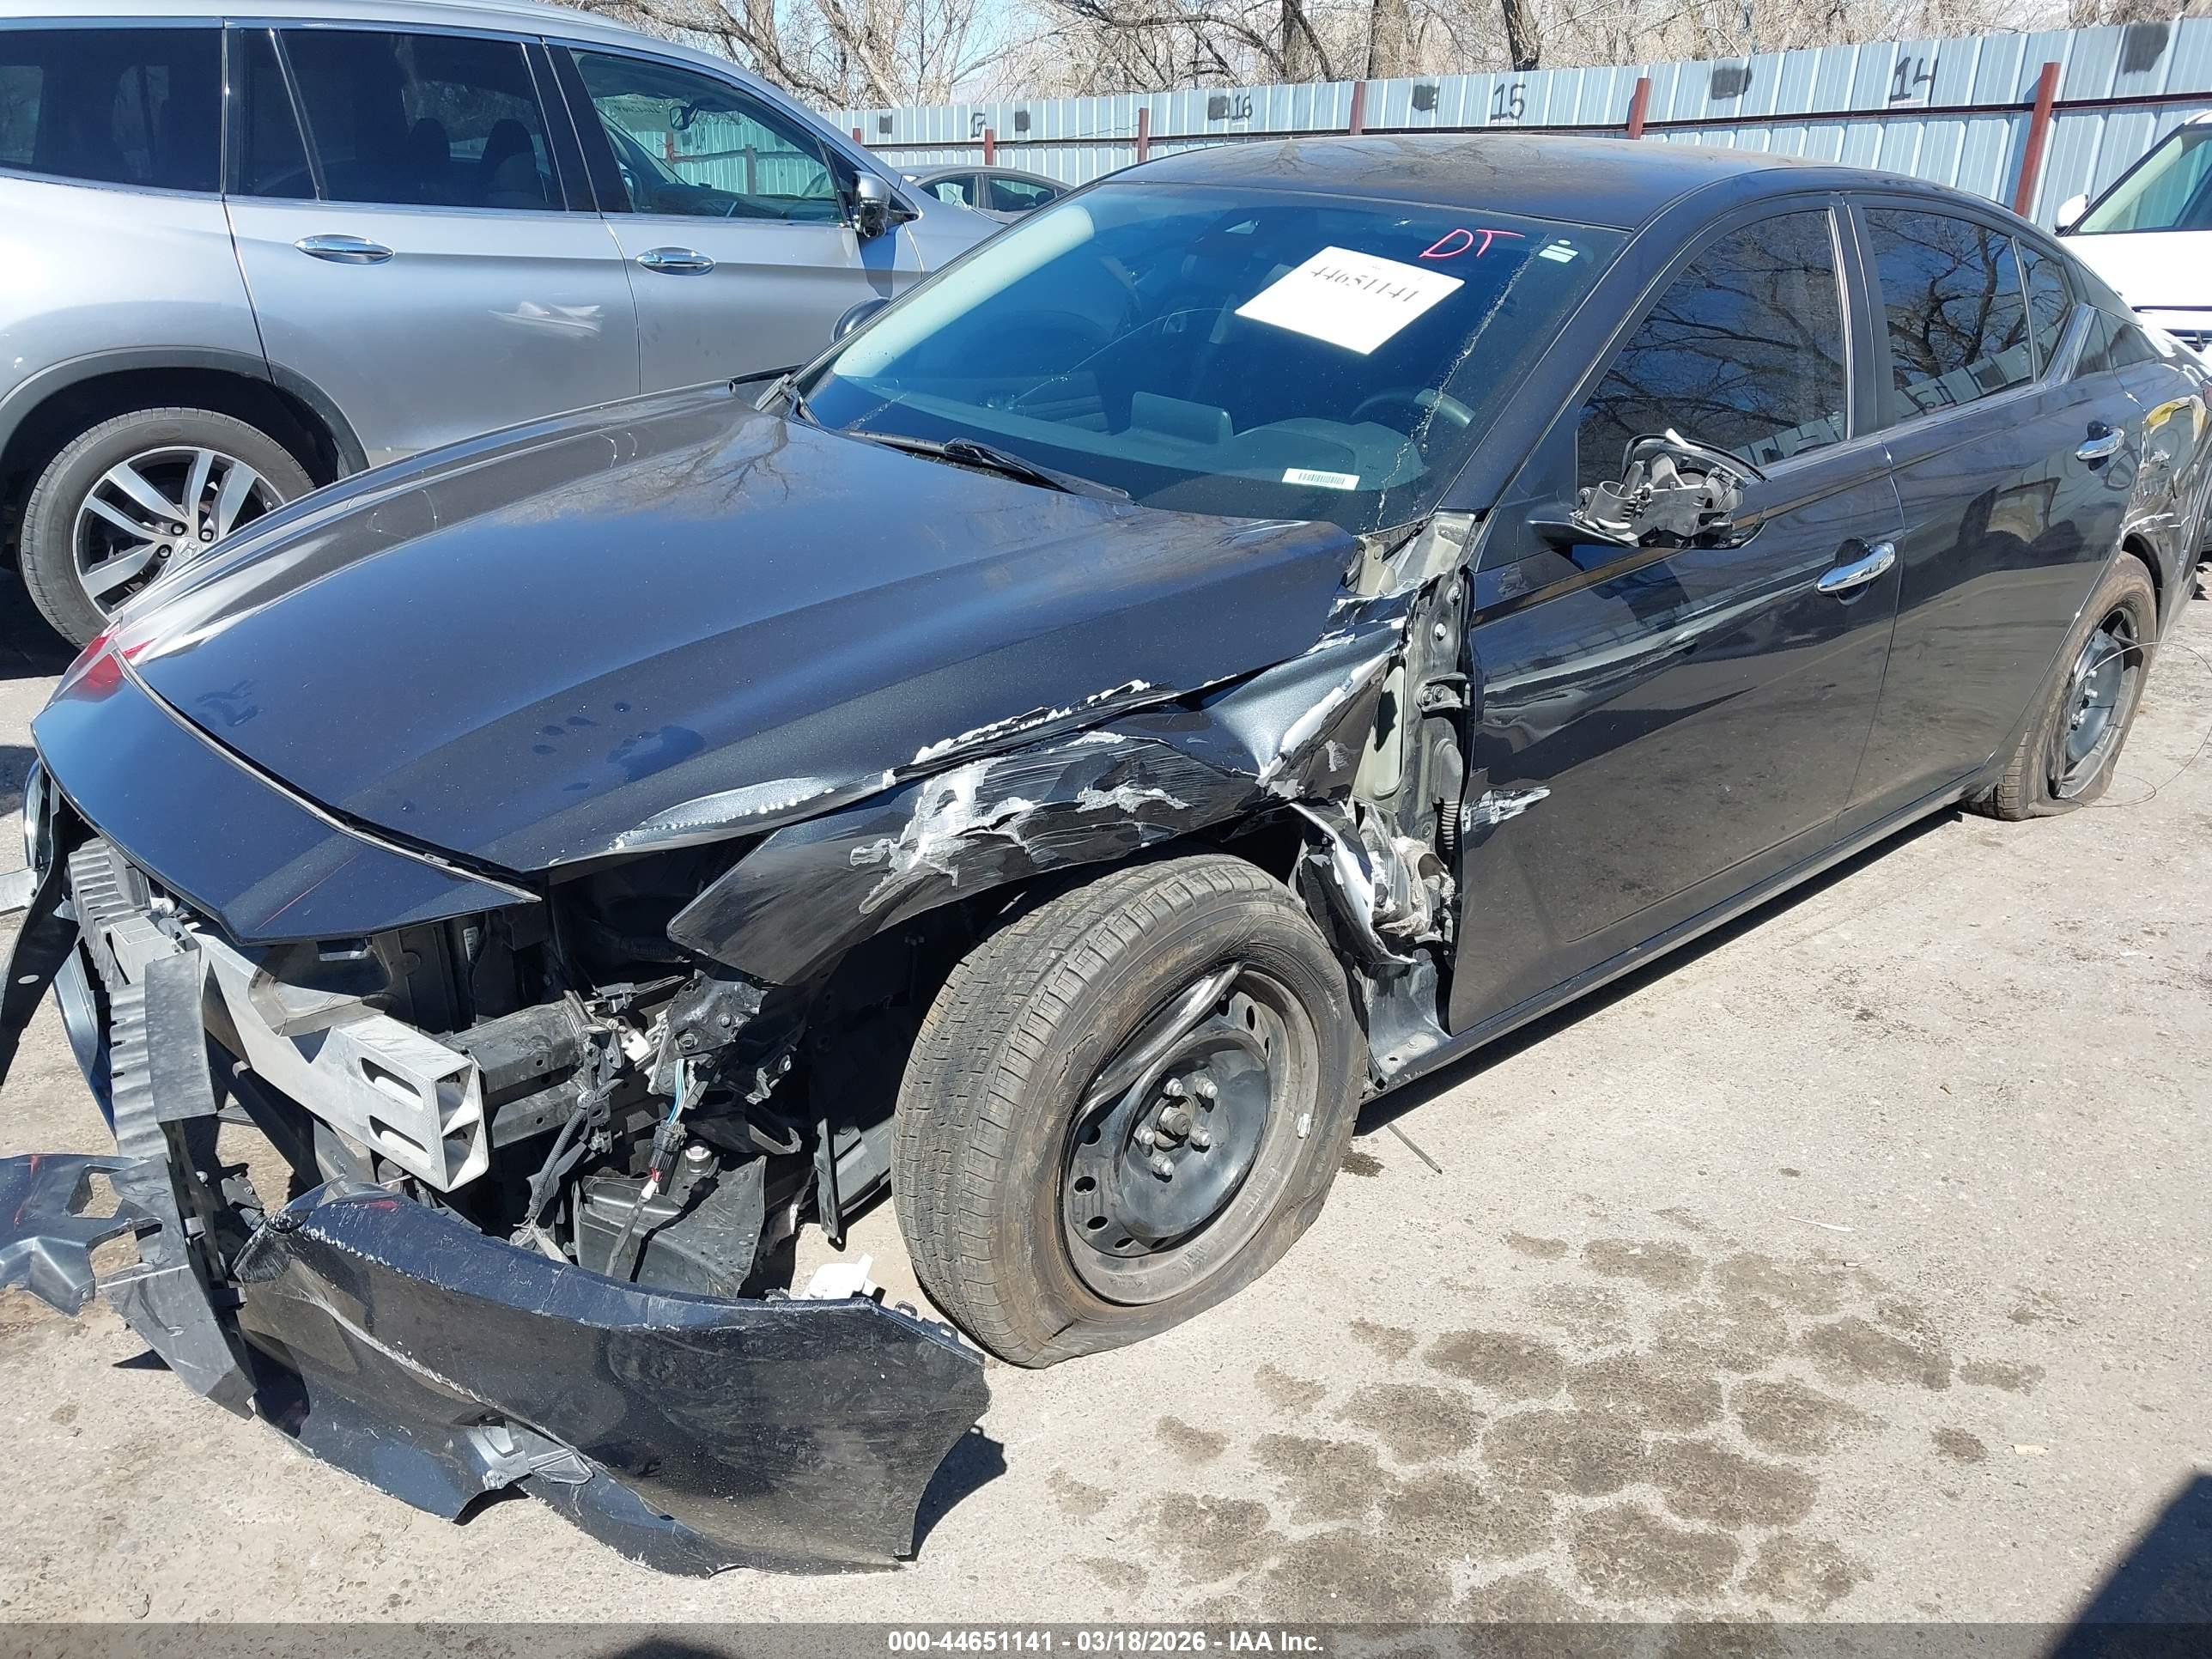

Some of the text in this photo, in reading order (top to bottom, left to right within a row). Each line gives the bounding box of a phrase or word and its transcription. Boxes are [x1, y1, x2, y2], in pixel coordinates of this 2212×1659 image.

[1889, 56, 1937, 103] 14
[1231, 94, 1253, 120] 16
[1490, 82, 1526, 120] 15
[1418, 228, 1526, 258] DT
